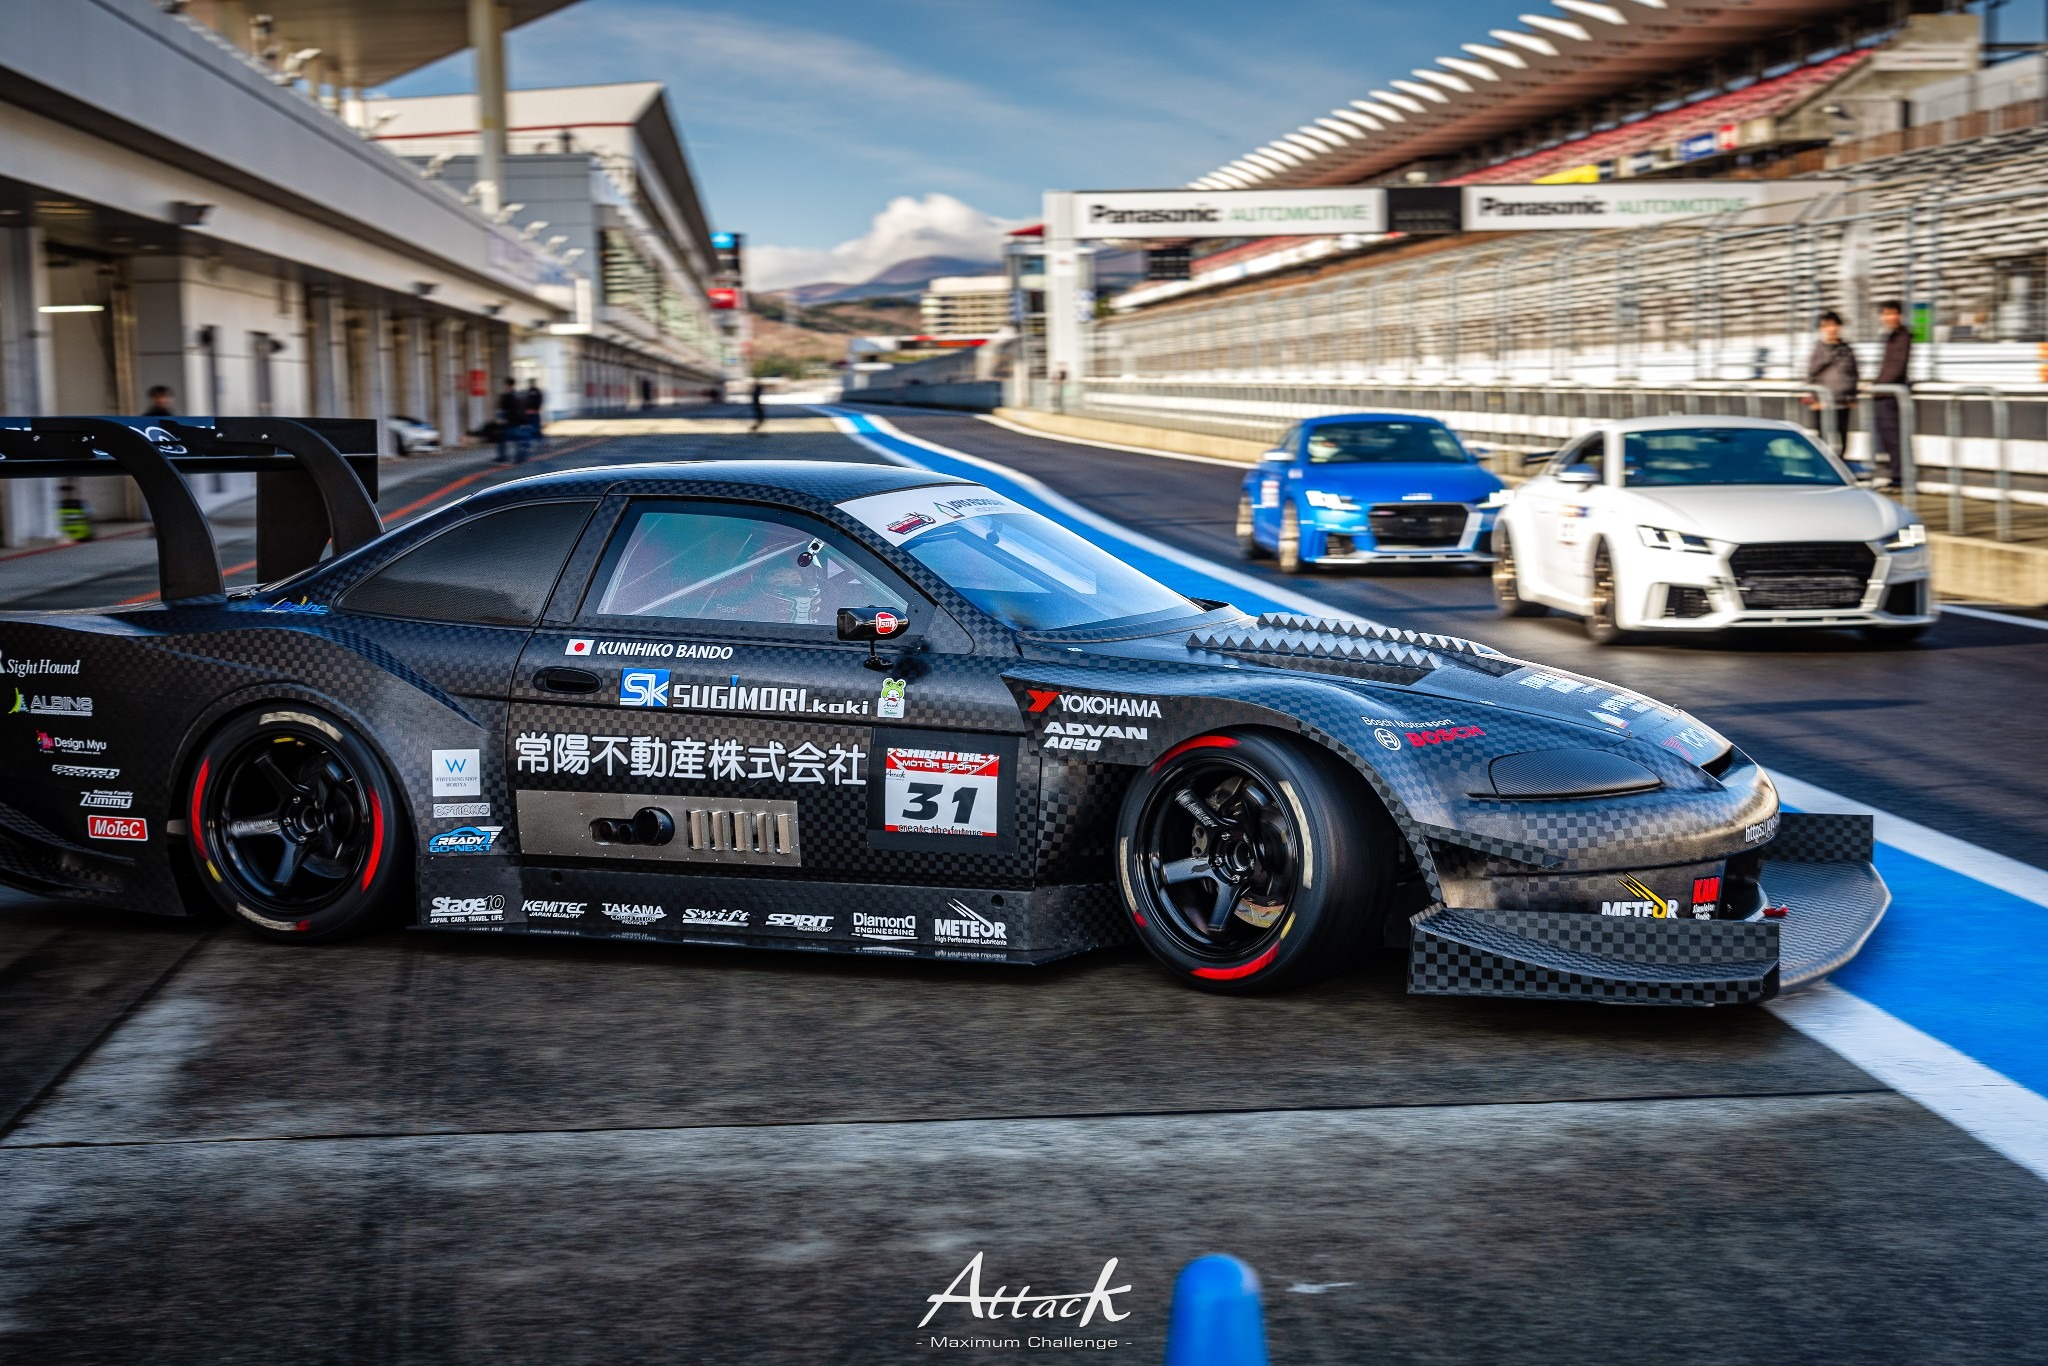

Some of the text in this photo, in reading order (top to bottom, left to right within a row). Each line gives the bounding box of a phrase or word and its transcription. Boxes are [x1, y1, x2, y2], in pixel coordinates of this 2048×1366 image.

[1088, 203, 1369, 223] Panasonic AUTOMOTIVE
[1478, 195, 1607, 216] Panasonic
[596, 641, 733, 660] KUNIHIKO BANDO
[1058, 694, 1162, 719] YOKOHAMA
[1043, 721, 1148, 740] ADVAN
[1361, 716, 1456, 729] Bosch Motorsport
[54, 737, 85, 751] Design
[86, 739, 107, 752] Myu
[1043, 736, 1102, 752] A050
[1404, 725, 1487, 748] BOSCH
[515, 731, 867, 786] 常陽不動産株式会社
[902, 758, 981, 772] MOTOR SPORT
[902, 782, 978, 824] 31
[94, 820, 141, 837] MoTeC
[429, 844, 492, 853] GO-NEXT
[438, 836, 486, 846] READY
[601, 902, 665, 915] TAKAMA
[765, 913, 835, 927] SPIRIT
[934, 914, 1008, 939] METEOR
[854, 926, 915, 937] ENGINEERING
[934, 935, 947, 944] High
[947, 936, 980, 945] Performance
